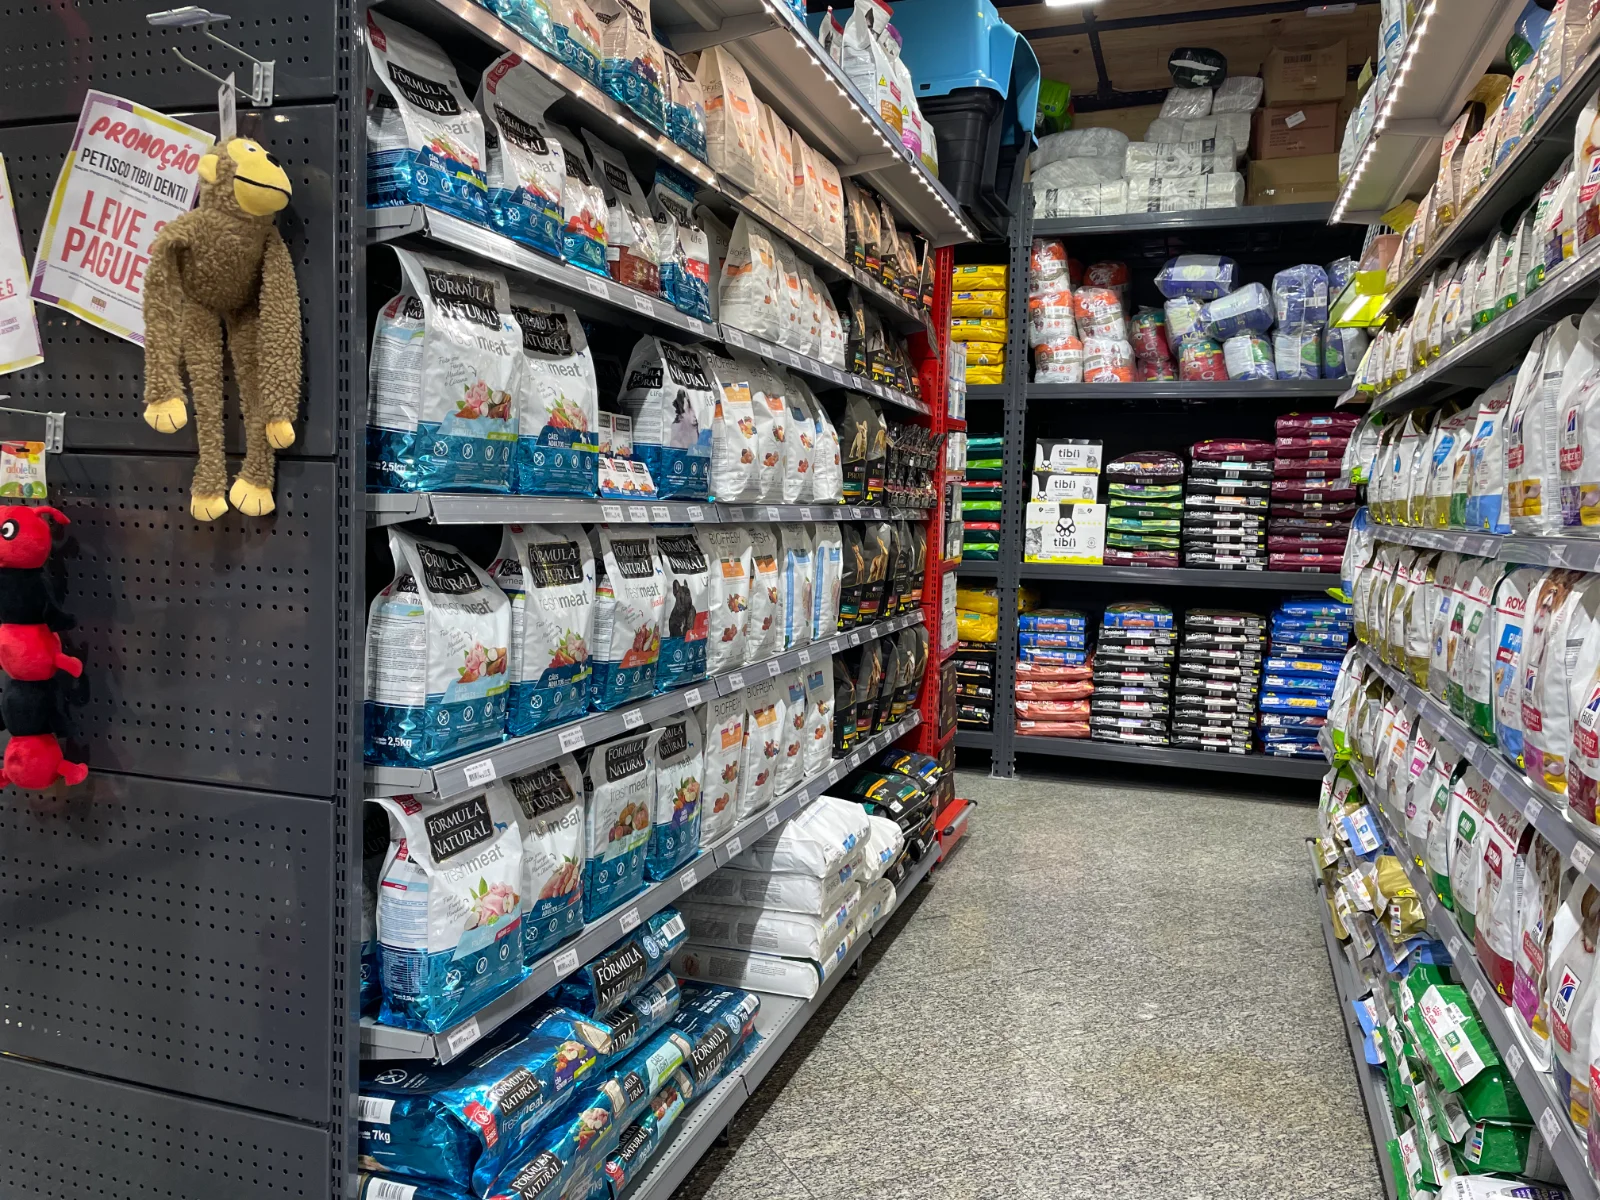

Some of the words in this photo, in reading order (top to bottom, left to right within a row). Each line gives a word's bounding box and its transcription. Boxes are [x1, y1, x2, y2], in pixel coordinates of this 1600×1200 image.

[392, 65, 449, 96] FÓRMULA
[400, 85, 457, 113] NATURAL
[88, 116, 200, 175] PROMOÇÃO
[81, 147, 130, 178] PETISCO
[131, 166, 154, 188] TIBII
[153, 177, 188, 204] DENTII
[79, 190, 147, 249] LEVE
[61, 226, 149, 294] PAGUE
[430, 274, 492, 304] FÓRMULA
[420, 549, 466, 571] FÓRMULA
[530, 548, 578, 564] FÓRMULA
[613, 543, 648, 557] FÓRMULA
[426, 572, 477, 591] NATURAL
[532, 565, 580, 582] NATURAL
[618, 560, 653, 575] NATURAL
[747, 681, 774, 699] BIOFRESH
[715, 698, 742, 717] BIOFRESH
[388, 736, 412, 748] 2,5kg
[608, 739, 645, 762] FÓRMULA
[660, 738, 686, 756] NATURAL
[609, 756, 646, 779] NATURAL
[610, 775, 649, 802] freshmeat
[428, 801, 486, 837] FÓRMULA
[435, 823, 491, 858] NATURAL
[443, 843, 505, 886] freshmeat
[596, 946, 642, 985] FÓRMULA
[692, 1027, 728, 1065] FÓRMULA
[491, 1069, 531, 1101] FÓRMULA
[501, 1078, 539, 1112] NATURAL
[502, 1093, 544, 1134] freshmeat
[373, 1130, 391, 1143] 7kg
[621, 1127, 648, 1160] NATURAL
[512, 1153, 553, 1190] FÓRMULA
[524, 1162, 561, 1200] NATURAL
